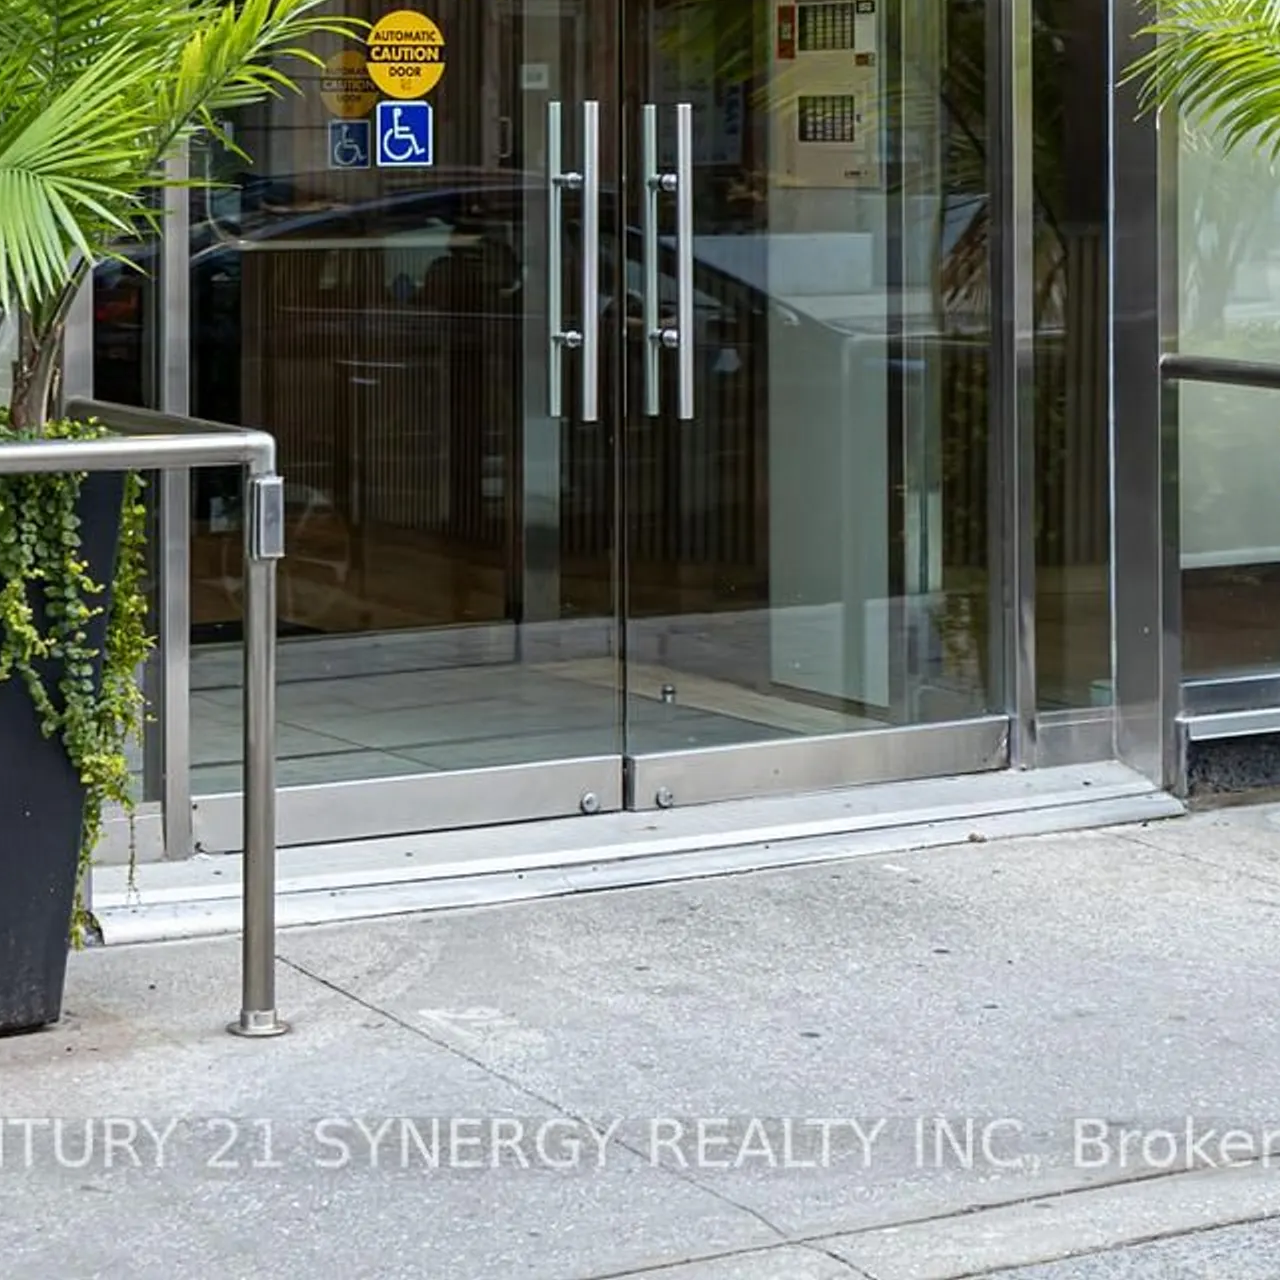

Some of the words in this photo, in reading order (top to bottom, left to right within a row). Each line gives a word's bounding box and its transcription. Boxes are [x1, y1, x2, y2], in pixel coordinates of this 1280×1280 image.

[373, 29, 437, 42] AUTOMATIC
[370, 46, 440, 61] CAUTION
[388, 65, 422, 77] DOOR
